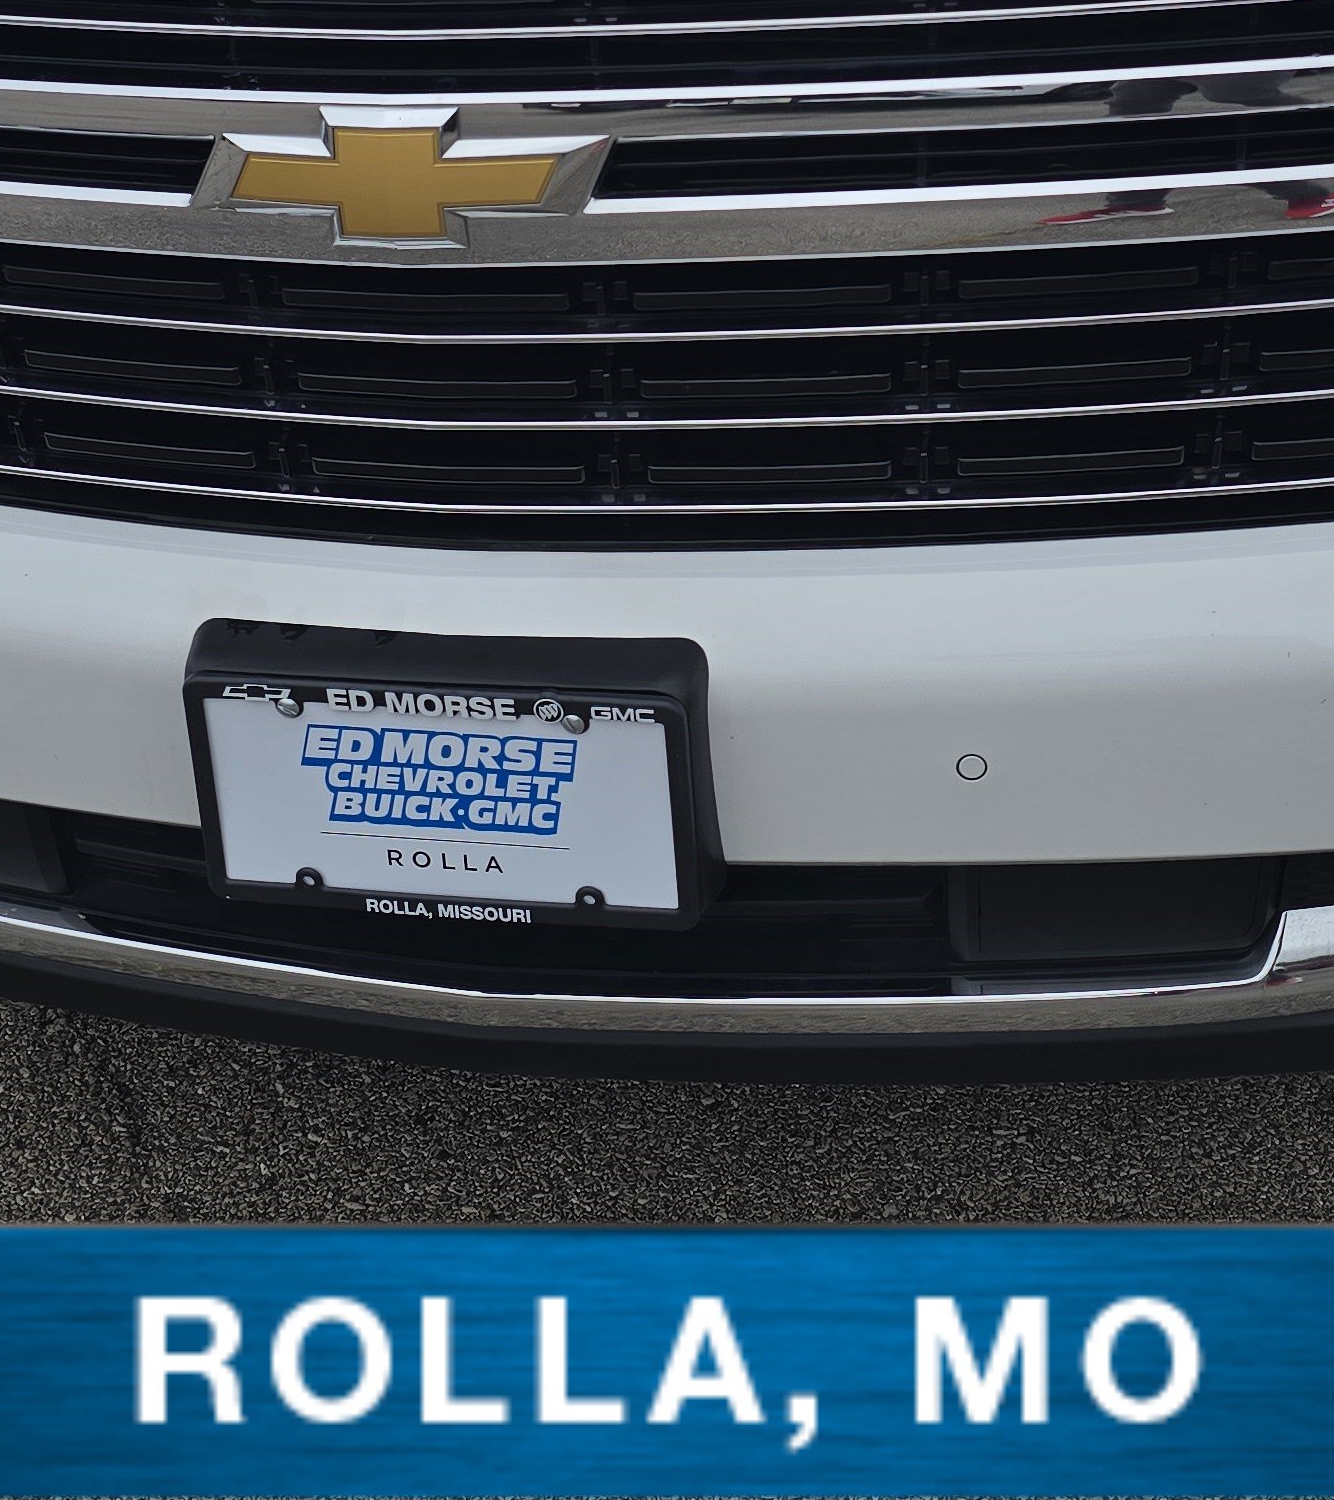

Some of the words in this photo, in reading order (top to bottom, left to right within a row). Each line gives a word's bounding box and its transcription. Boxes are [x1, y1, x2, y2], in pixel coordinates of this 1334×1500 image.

[326, 688, 375, 713] ED
[385, 691, 517, 721] MORSE
[590, 706, 655, 724] GMC
[304, 727, 375, 761] ED
[380, 731, 575, 774] MORSE
[328, 762, 556, 800] CHEVROLET
[386, 849, 504, 874] ROLLA
[365, 898, 433, 920] ROLLA,
[438, 903, 532, 924] MISSOURI
